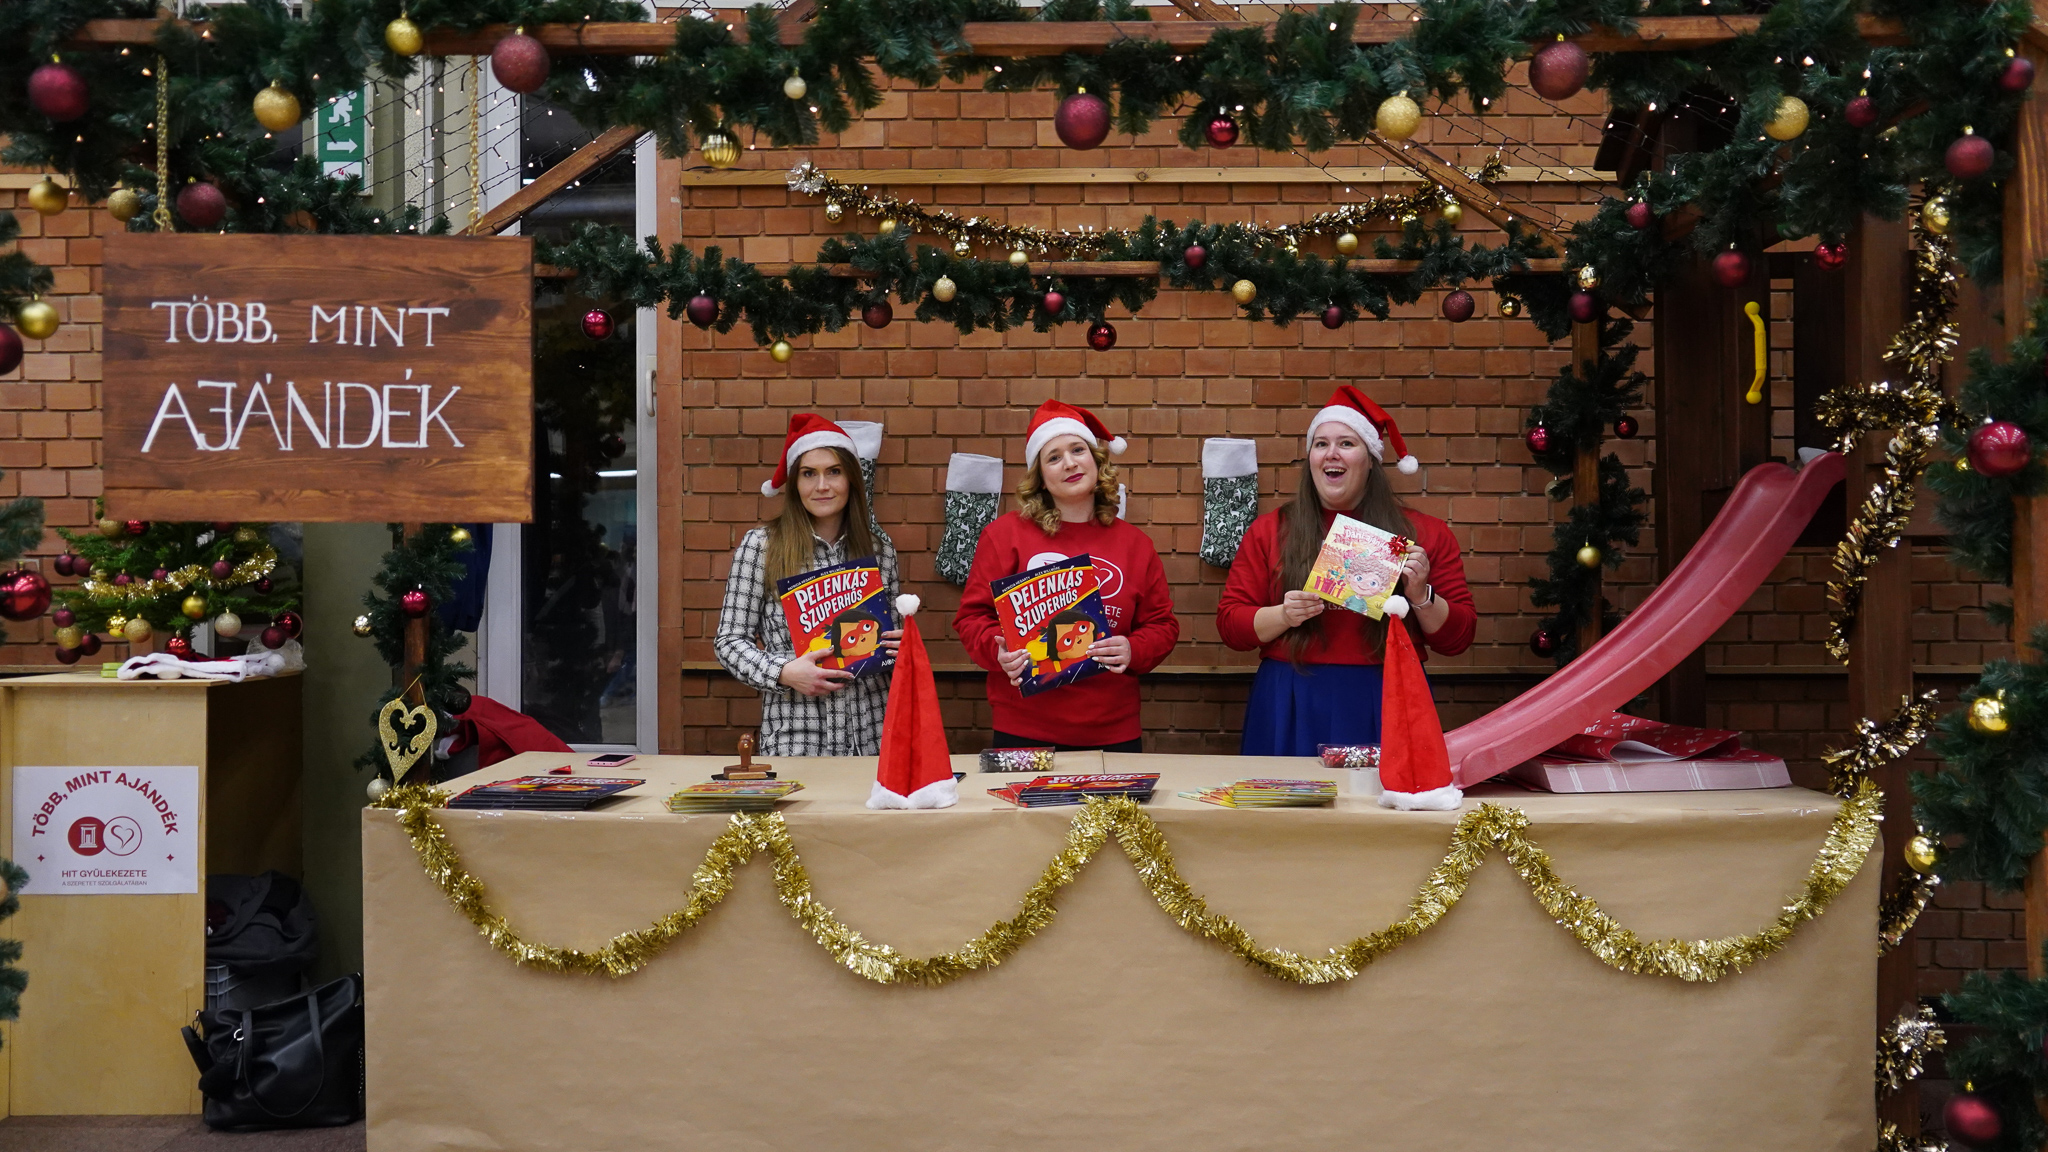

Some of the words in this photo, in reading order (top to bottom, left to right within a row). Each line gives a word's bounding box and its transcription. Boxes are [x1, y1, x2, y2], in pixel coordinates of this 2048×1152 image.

[151, 294, 278, 344] TÖBB,
[309, 304, 450, 347] MINT
[141, 368, 465, 453] AJÁNDÉK
[794, 565, 869, 613] PELENKÁS
[798, 588, 863, 634] SZUPERHŐS
[1009, 565, 1084, 615] PELENKÁS
[1013, 588, 1078, 638] SZUPERHŐS
[1103, 604, 1122, 618] ETE
[32, 791, 69, 837] TÖBB,
[64, 770, 112, 794] MINT
[114, 772, 179, 836] AJÁNDÉK
[61, 869, 78, 878] HIT
[79, 868, 148, 878] GYÜLEKEZETE
